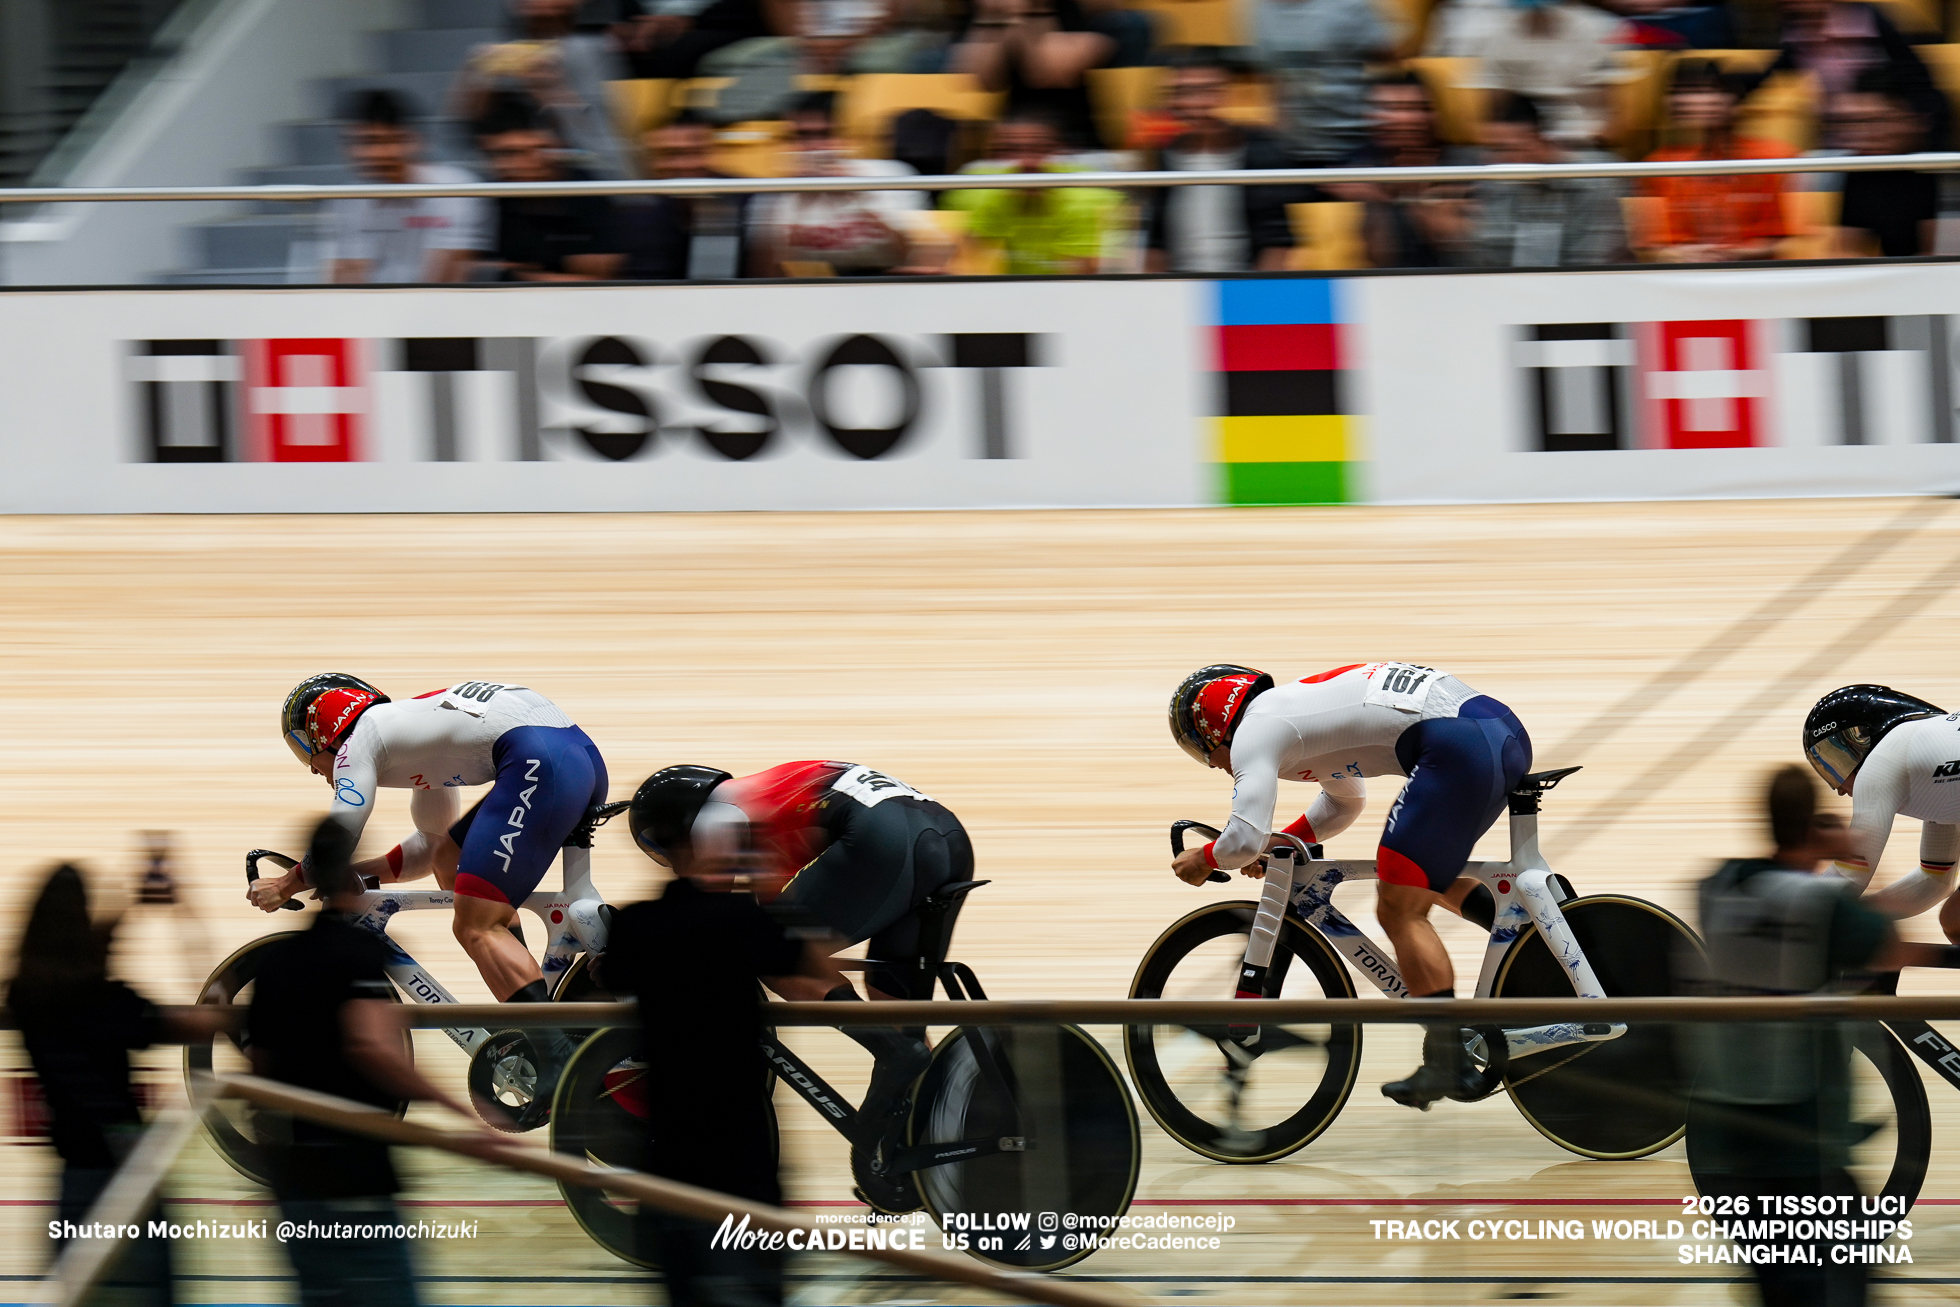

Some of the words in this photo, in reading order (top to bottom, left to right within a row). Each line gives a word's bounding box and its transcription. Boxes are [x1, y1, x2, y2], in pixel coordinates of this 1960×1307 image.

[390, 331, 1046, 463] TISSOT
[333, 693, 367, 732] JAPAN
[452, 681, 505, 703] 168
[1221, 676, 1248, 722] JAPAN
[1812, 721, 1838, 738] CASCO
[493, 759, 541, 874] JAPAN
[758, 1044, 848, 1120] ARDUS
